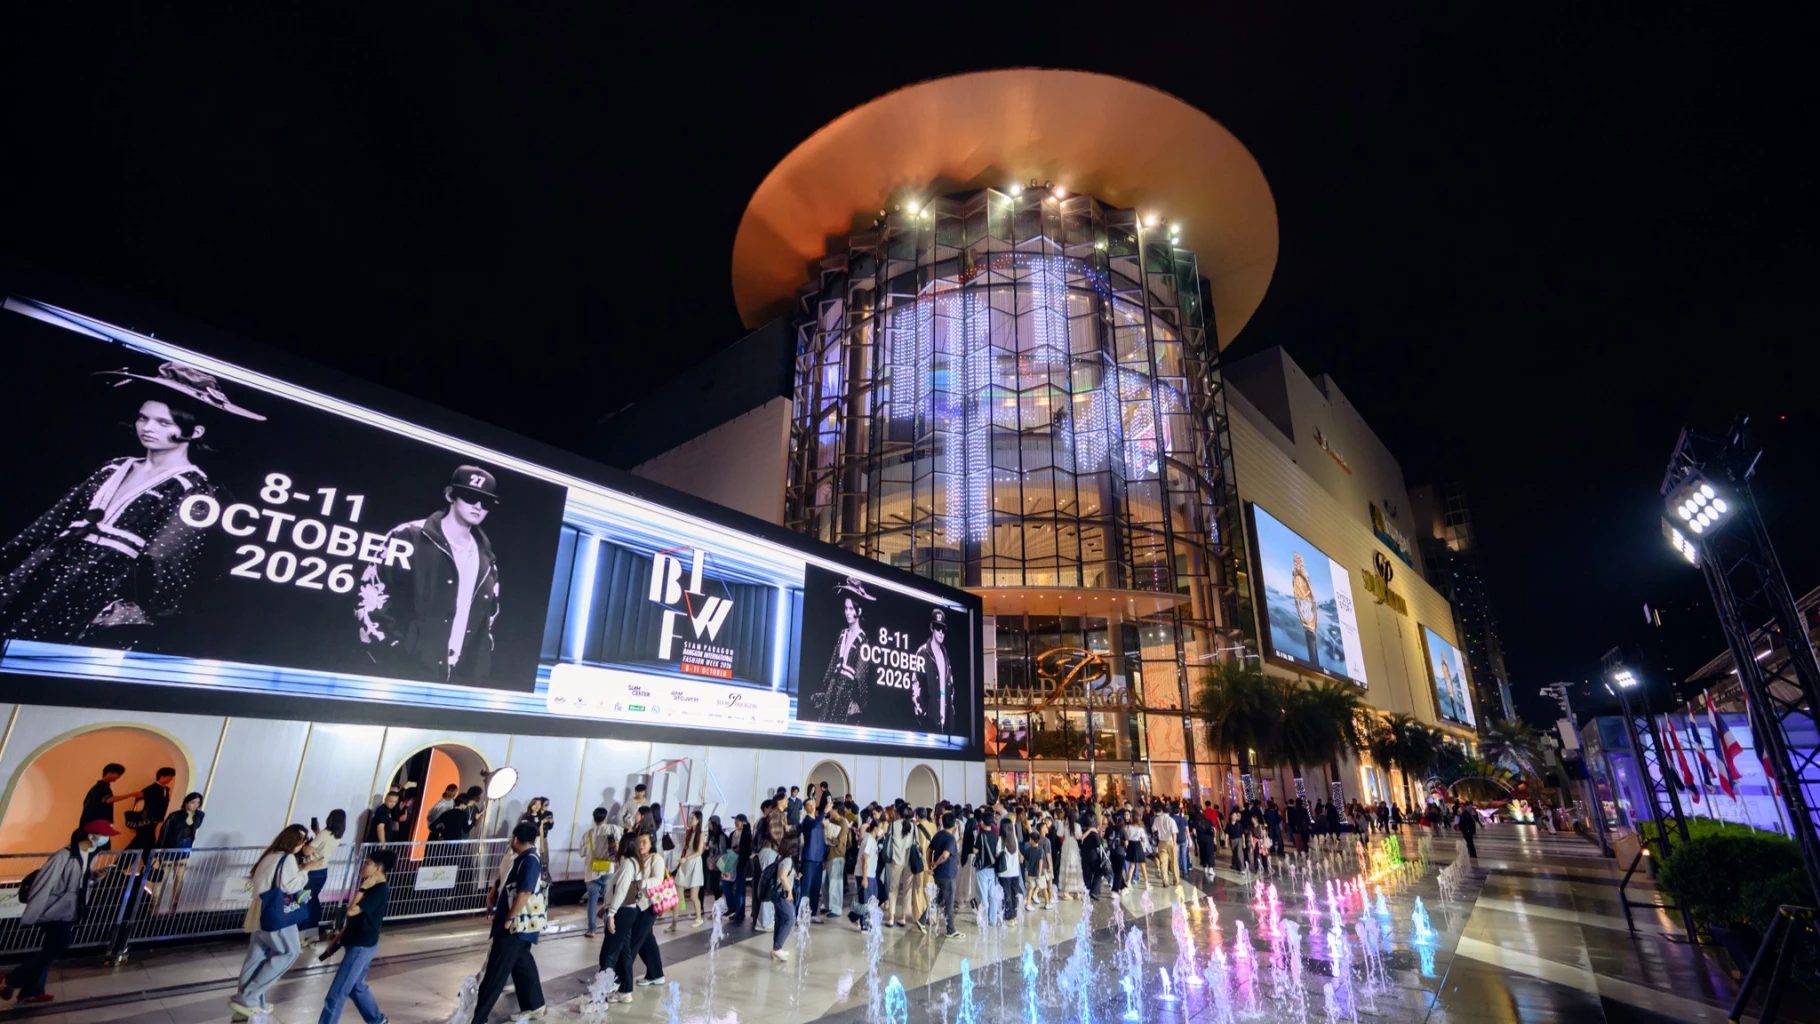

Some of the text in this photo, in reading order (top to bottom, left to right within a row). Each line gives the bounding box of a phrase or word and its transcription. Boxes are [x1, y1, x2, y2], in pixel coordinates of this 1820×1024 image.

[470, 474, 486, 488] 27
[260, 472, 365, 523] 8-11
[179, 494, 415, 570] OCTOBER
[230, 544, 355, 594] 2026
[683, 641, 734, 656] SIAM PARAGON
[879, 627, 909, 650] 8-11
[860, 643, 926, 674] OCTOBER
[876, 667, 911, 690] 2026
[983, 677, 1147, 712] SIAM PARAGON
